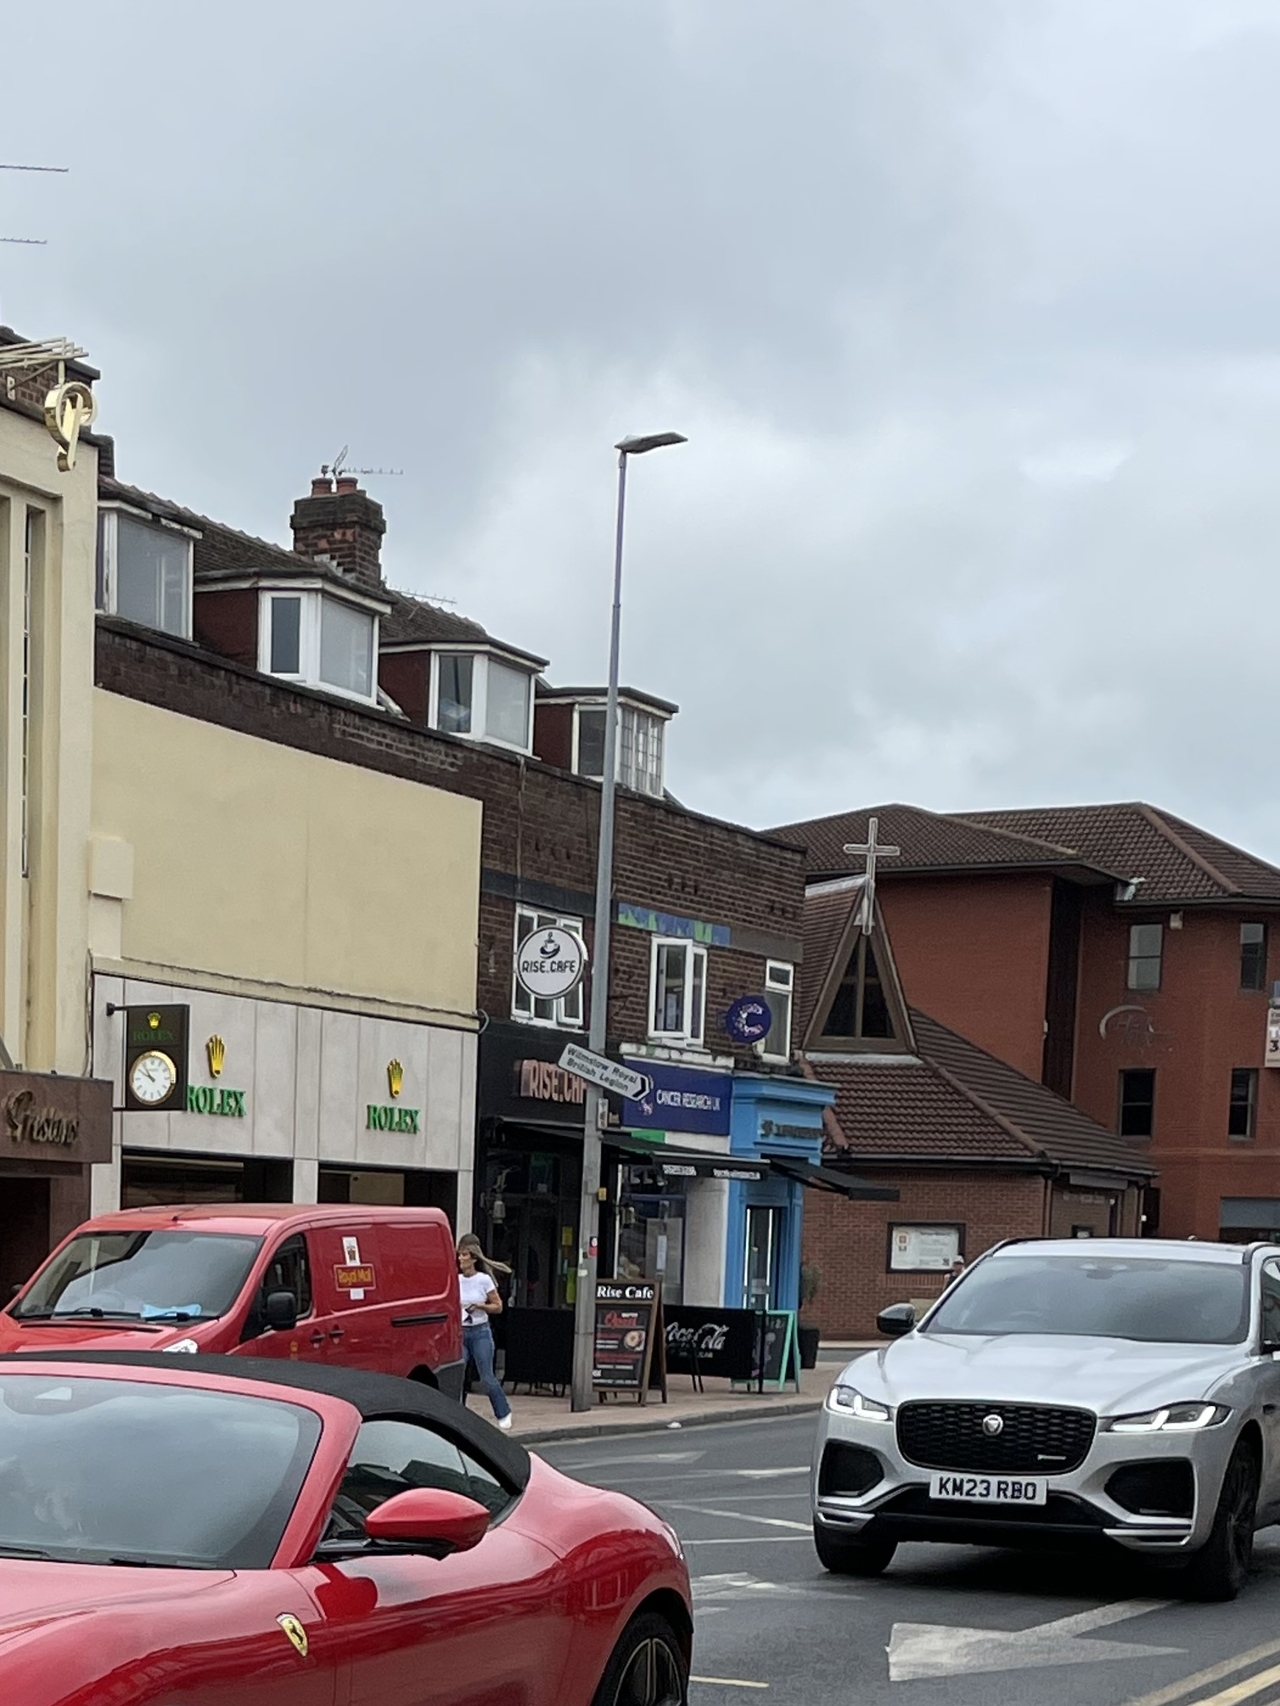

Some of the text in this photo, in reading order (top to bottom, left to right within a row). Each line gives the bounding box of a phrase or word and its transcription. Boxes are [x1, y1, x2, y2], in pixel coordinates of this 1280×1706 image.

[133, 1029, 174, 1041] ROLEX
[567, 1058, 629, 1091] British Legion
[612, 1065, 637, 1083] Royal
[366, 1104, 420, 1134] ROLEX
[338, 1267, 372, 1286] Royal Mail
[597, 1285, 654, 1299] Rise Cafe
[939, 1476, 1037, 1500] KM23 RBO
